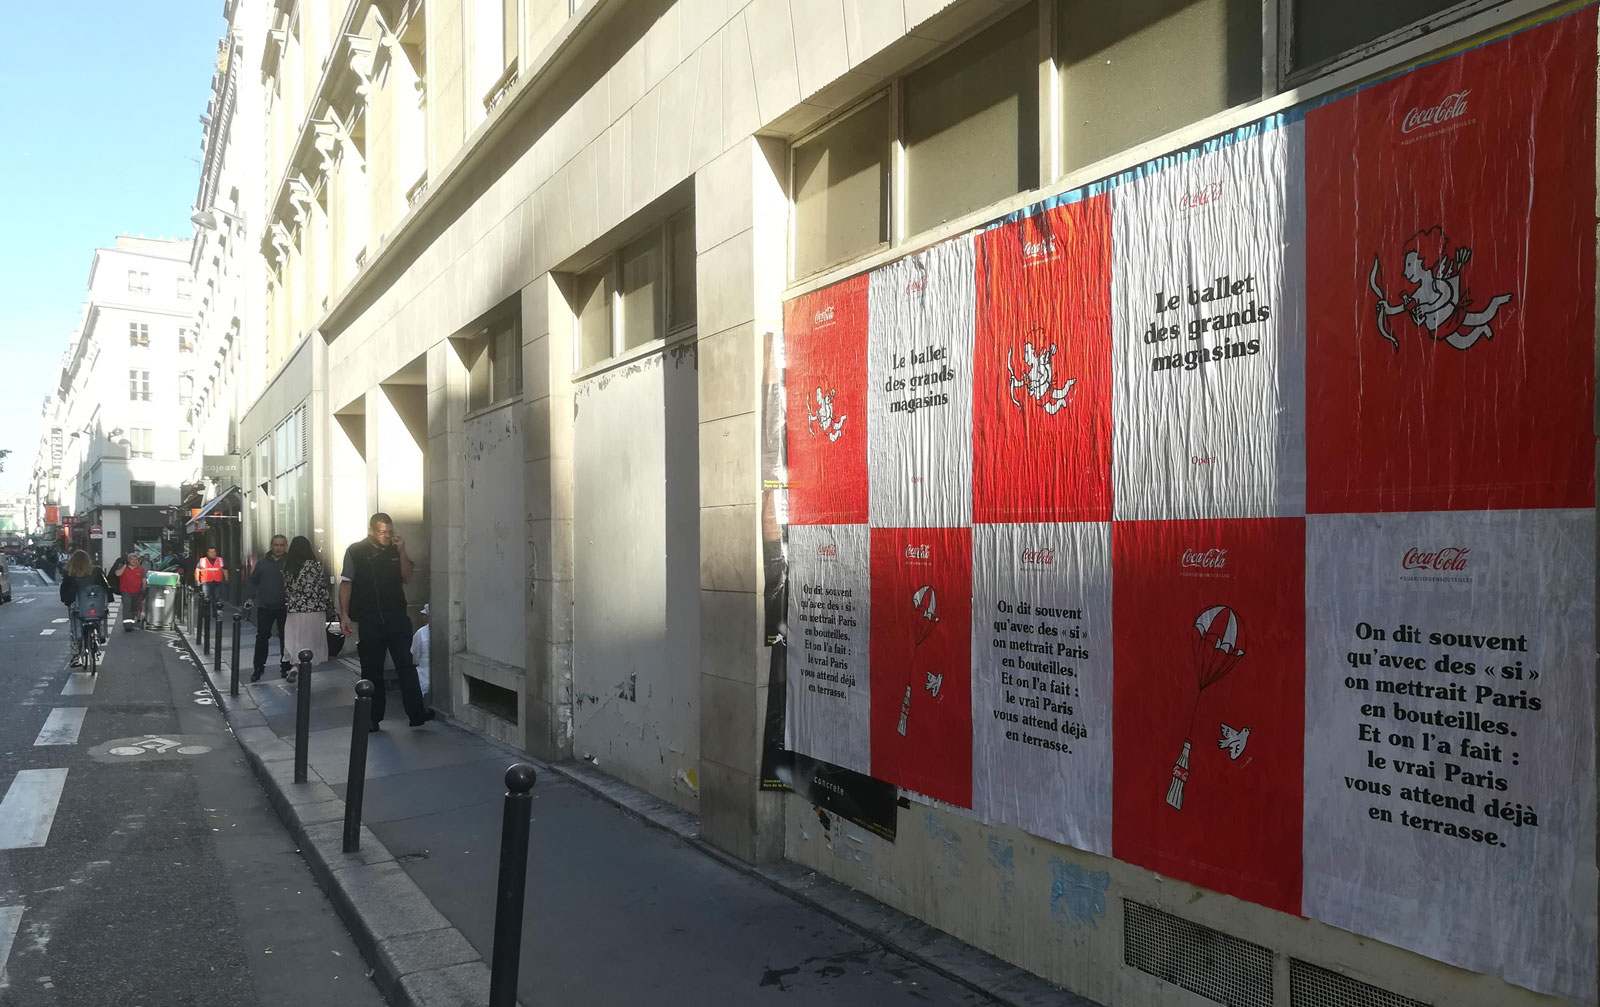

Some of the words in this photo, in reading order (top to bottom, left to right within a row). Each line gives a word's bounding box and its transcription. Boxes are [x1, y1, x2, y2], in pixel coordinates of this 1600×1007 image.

[1401, 88, 1472, 134] Coca-Cola
[1156, 292, 1180, 313] Le
[1187, 272, 1255, 306] ballet
[1144, 321, 1180, 344] des
[1188, 301, 1270, 341] grands
[893, 353, 905, 370] Le
[910, 345, 947, 366] ballet
[1153, 337, 1260, 371] magasins
[885, 375, 906, 392] des
[910, 365, 954, 391] grands
[890, 390, 948, 413] magasins
[53, 430, 62, 470] HOTEL
[204, 463, 237, 473] cojean
[1181, 548, 1228, 568] Coca-Cola
[1402, 547, 1471, 571] Coca-Cola
[803, 584, 812, 595] On
[813, 585, 823, 595] dit
[825, 587, 852, 598] souvent
[827, 600, 839, 611] des
[845, 602, 852, 611] si
[997, 600, 1013, 614] On
[1017, 601, 1031, 615] dit
[1035, 606, 1083, 620] souvent
[799, 613, 807, 621] on
[809, 614, 836, 625] mettrait
[838, 615, 857, 627] Paris
[1038, 622, 1058, 636] des
[1069, 626, 1080, 639] si
[804, 628, 812, 636] en
[813, 627, 850, 641] bouteilles.
[1356, 622, 1385, 641] On
[1393, 624, 1421, 643] dit
[1429, 631, 1528, 652] souvent
[804, 640, 812, 650] Et
[813, 643, 822, 651] on
[834, 644, 847, 655] fait
[993, 638, 1006, 648] on
[1009, 639, 1053, 655] mettrait
[1057, 643, 1089, 660] Paris
[807, 653, 814, 663] le
[815, 657, 828, 667] vrai
[830, 657, 848, 670] Paris
[1002, 657, 1015, 667] en
[1018, 656, 1077, 678] bouteilles.
[1347, 648, 1427, 670] qu'avec
[1435, 655, 1476, 675] des
[1484, 665, 1495, 676] «
[1501, 661, 1523, 680] si
[1529, 669, 1539, 680] »
[800, 668, 815, 678] vous
[816, 669, 838, 683] attend
[840, 673, 856, 688] déjà
[1001, 671, 1013, 685] Et
[1016, 678, 1029, 688] on
[1050, 679, 1071, 696] fait
[808, 683, 816, 693] en
[817, 684, 847, 700] terrasse.
[1005, 691, 1016, 704] le
[1019, 696, 1039, 709] vrai
[1043, 697, 1073, 716] Paris
[1345, 676, 1369, 690] on
[1376, 679, 1467, 702] mettrait
[1476, 685, 1542, 711] Paris
[993, 709, 1018, 723] vous
[1022, 714, 1058, 732] attend
[1061, 720, 1088, 739] déjà
[1361, 703, 1386, 718] en
[1393, 702, 1517, 737] bouteilles.
[1006, 730, 1019, 741] en
[1023, 733, 1072, 754] terrasse.
[1358, 724, 1381, 743] Et
[1388, 732, 1415, 749] on
[1422, 733, 1451, 754] l'a
[1460, 738, 1502, 762] fait
[1512, 752, 1519, 766] :
[1367, 750, 1386, 768] le
[1393, 761, 1435, 778] vrai
[1444, 763, 1508, 791] Paris
[1344, 776, 1391, 796] vous
[1400, 786, 1475, 813] attend
[1484, 799, 1539, 827] déjà
[1368, 807, 1392, 823] en
[1400, 810, 1507, 848] terrasse.
